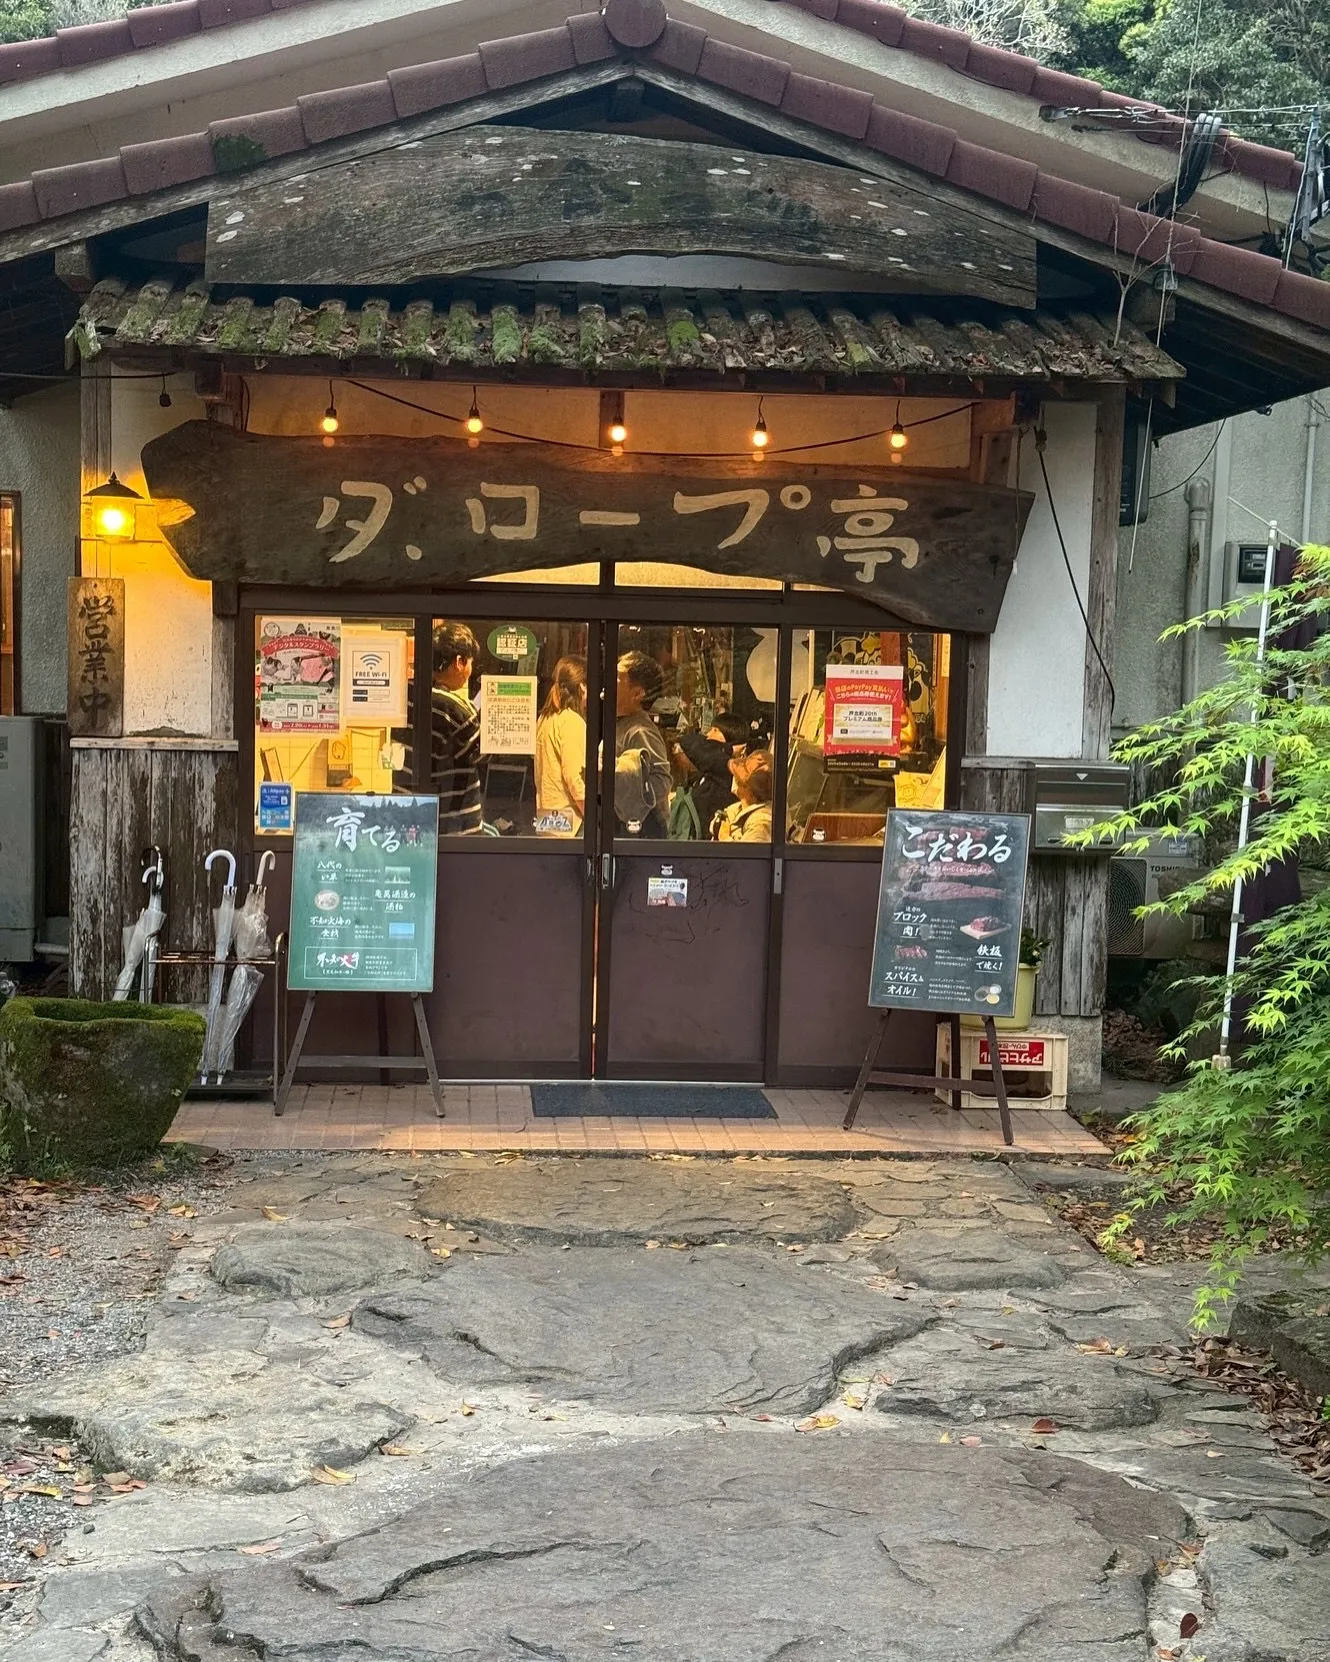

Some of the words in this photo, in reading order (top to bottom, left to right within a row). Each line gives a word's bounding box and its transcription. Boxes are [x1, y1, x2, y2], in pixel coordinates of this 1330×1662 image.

[78, 595, 117, 728] 営業中
[326, 806, 400, 853] 育てる
[902, 824, 1012, 863] こだわる
[317, 860, 342, 869] 八代の
[309, 915, 352, 926] 不知火海の
[893, 911, 927, 923] ブロック
[976, 944, 1003, 957] 鉄板
